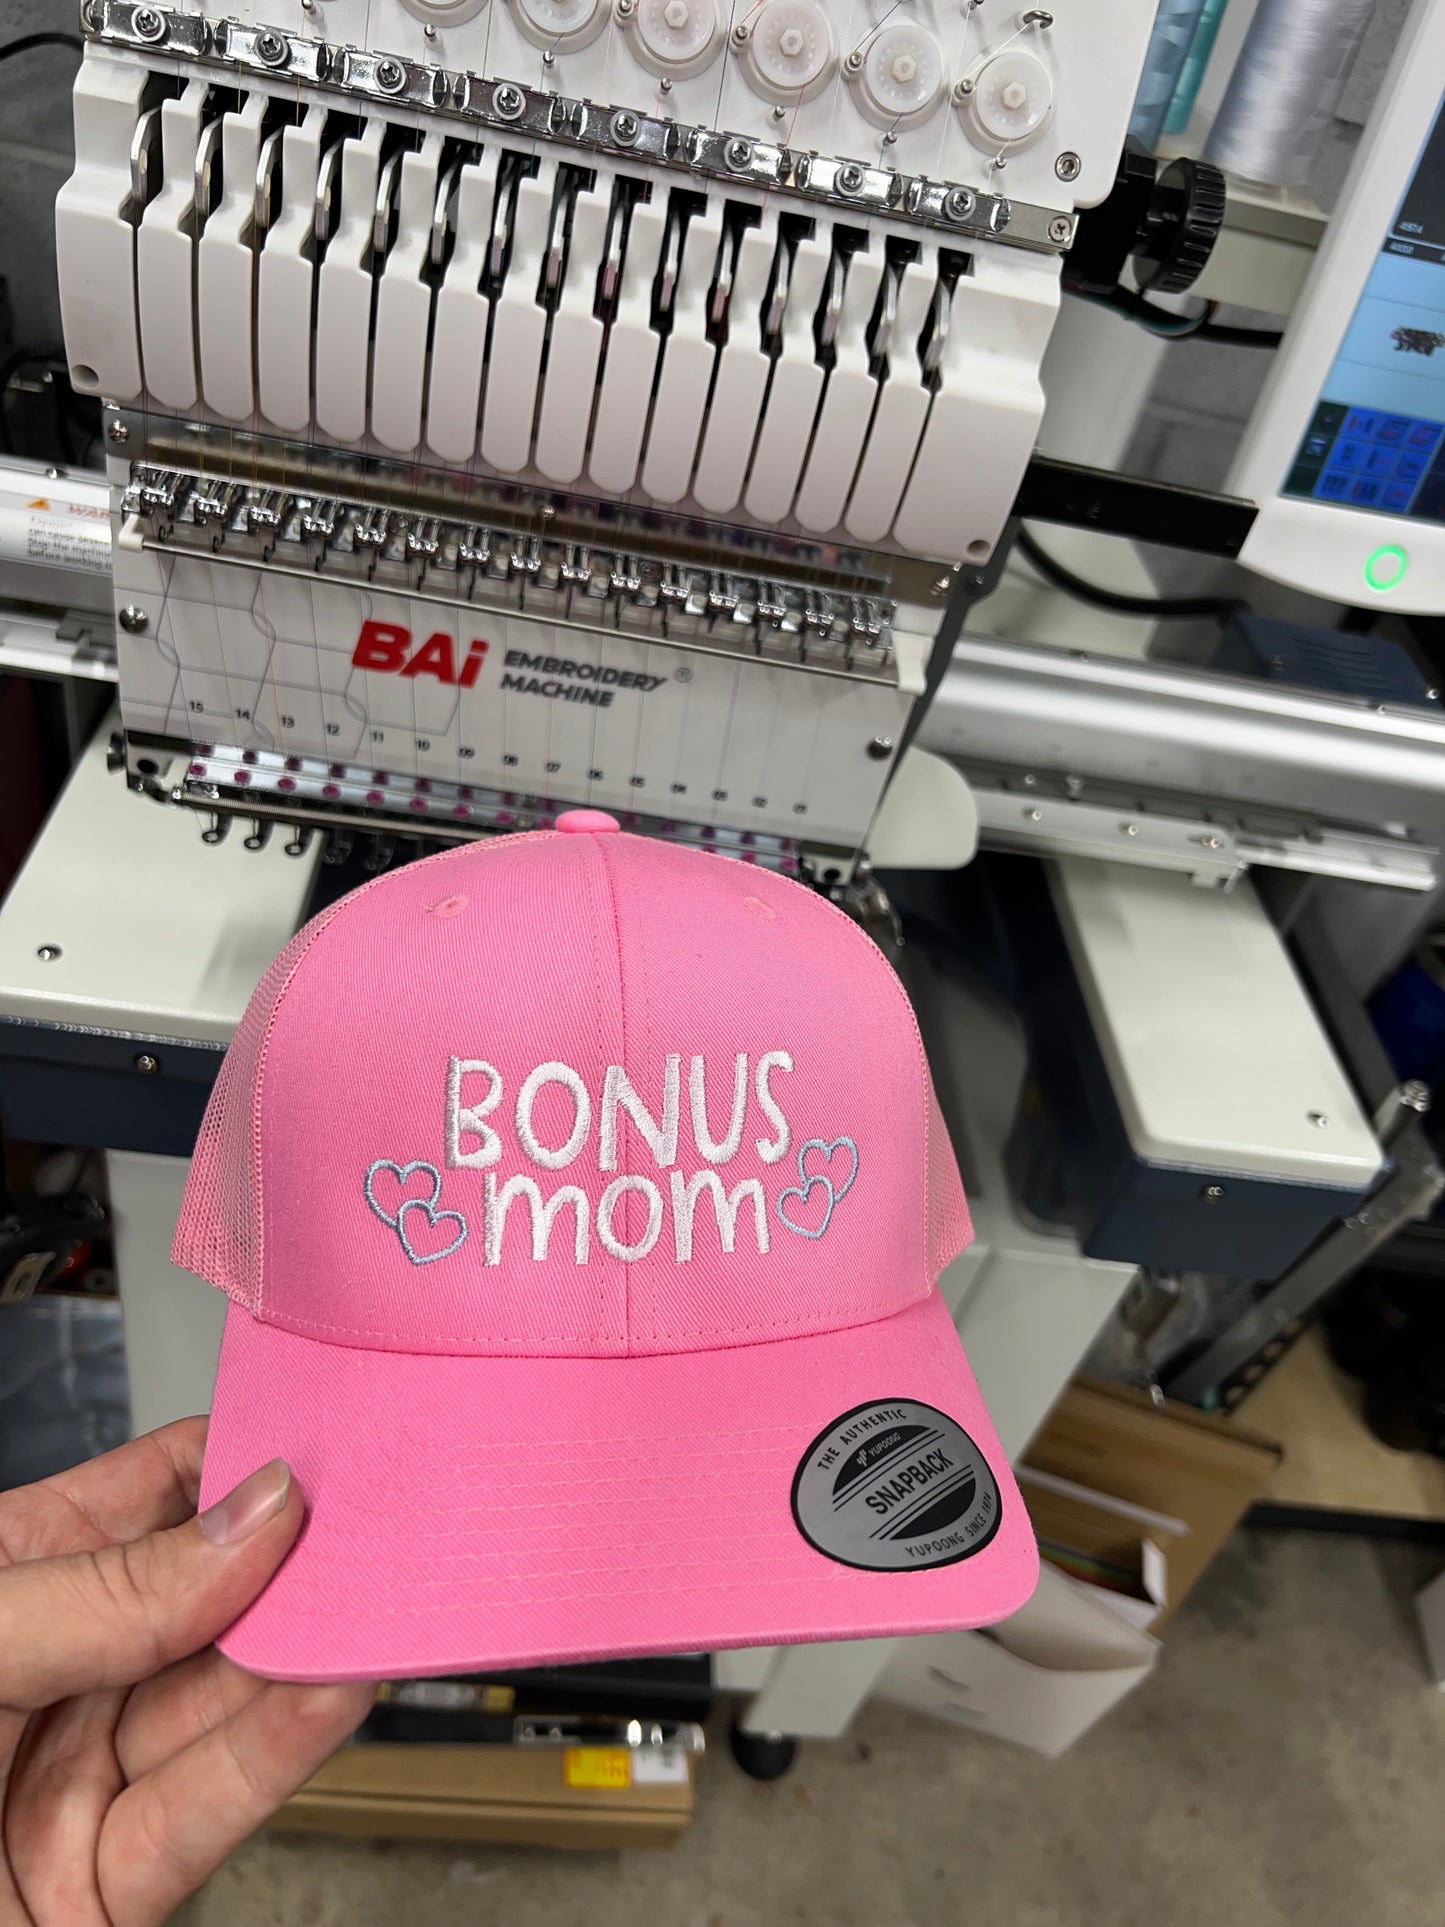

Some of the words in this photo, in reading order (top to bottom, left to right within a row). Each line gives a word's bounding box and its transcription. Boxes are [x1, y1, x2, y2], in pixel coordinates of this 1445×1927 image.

[500, 673, 615, 708] MACHINE
[503, 649, 668, 692] EMBROIDERY
[190, 701, 204, 713] 15
[236, 709, 250, 720] 14
[281, 716, 295, 728] 13
[326, 723, 340, 736] 12
[372, 731, 384, 743] 11
[416, 738, 430, 751] 10
[443, 1050, 795, 1171] BONUS
[817, 1446, 840, 1471] THE
[839, 1408, 907, 1446] AUTHENTIC
[869, 1432, 901, 1457] YUPOONG
[865, 1447, 954, 1515] SNAPBACK
[904, 1531, 965, 1558] YUPOONG
[964, 1513, 987, 1537] SINCE
